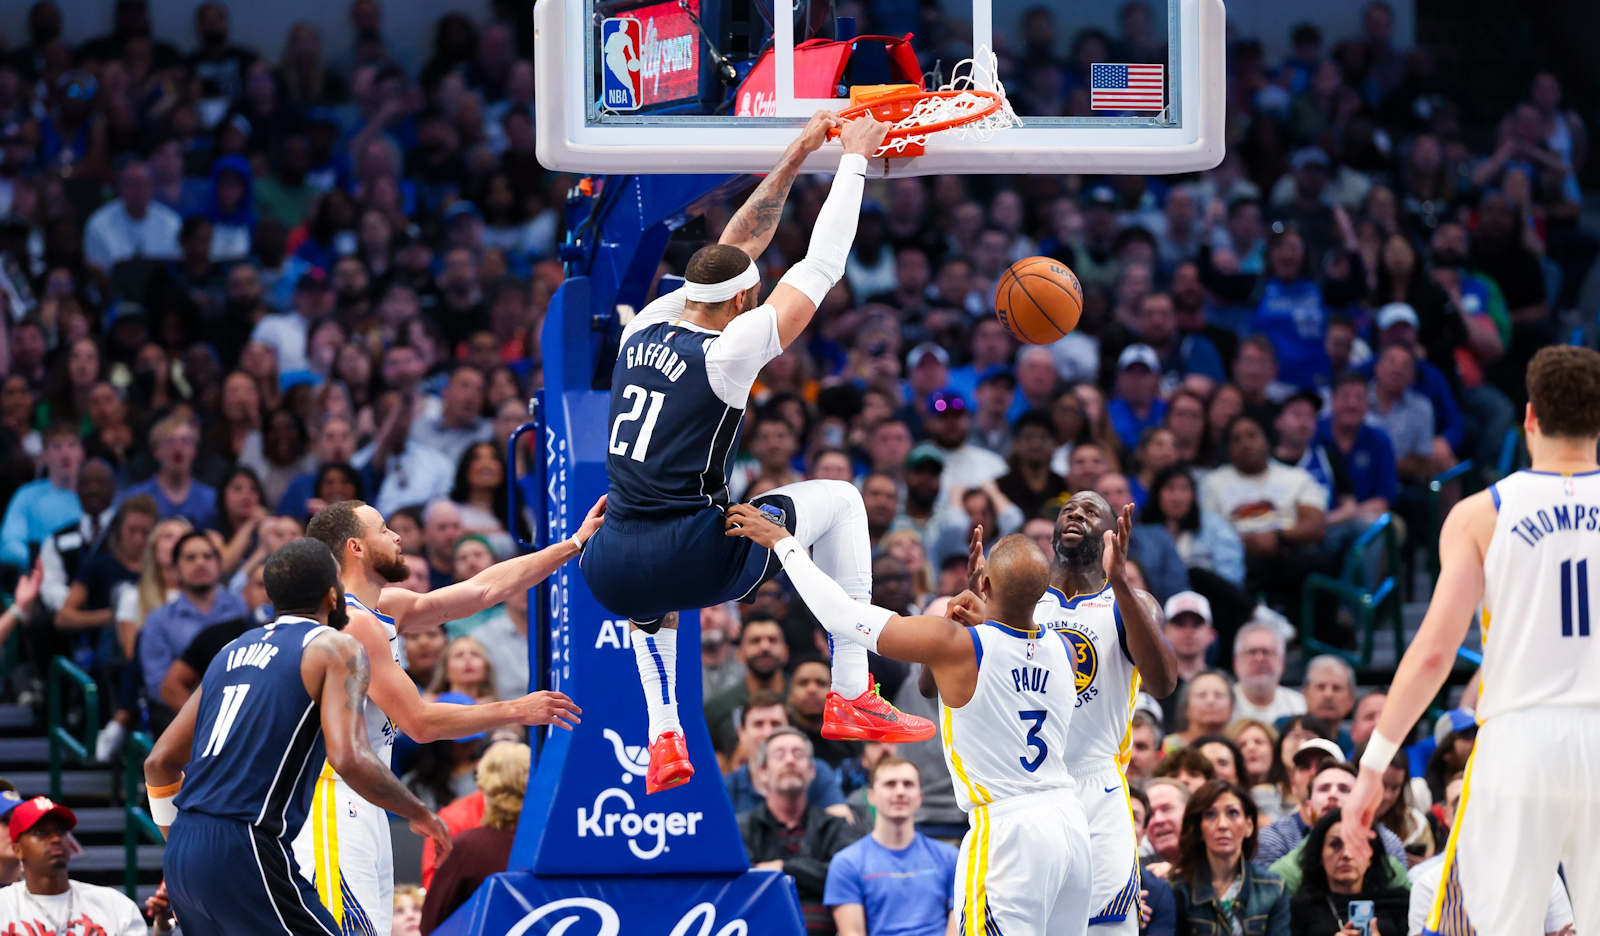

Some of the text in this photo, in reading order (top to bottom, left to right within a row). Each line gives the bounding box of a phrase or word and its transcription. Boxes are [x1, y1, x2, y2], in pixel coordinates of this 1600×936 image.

[642, 16, 693, 95] lly SPORTS
[609, 89, 628, 104] NBA
[626, 342, 688, 383] GAFFORD
[609, 384, 666, 463] 21
[1511, 504, 1600, 547] THOMPS
[1560, 558, 1590, 637] 11
[594, 619, 632, 649] AT
[1047, 620, 1099, 643] DEN STATE
[226, 642, 279, 672] IRVING
[1075, 642, 1088, 664] 3
[1011, 666, 1050, 694] PAUL
[1075, 685, 1099, 709] ORS
[201, 683, 251, 758] 11
[1018, 710, 1048, 773] 3
[577, 787, 703, 860] Kroger
